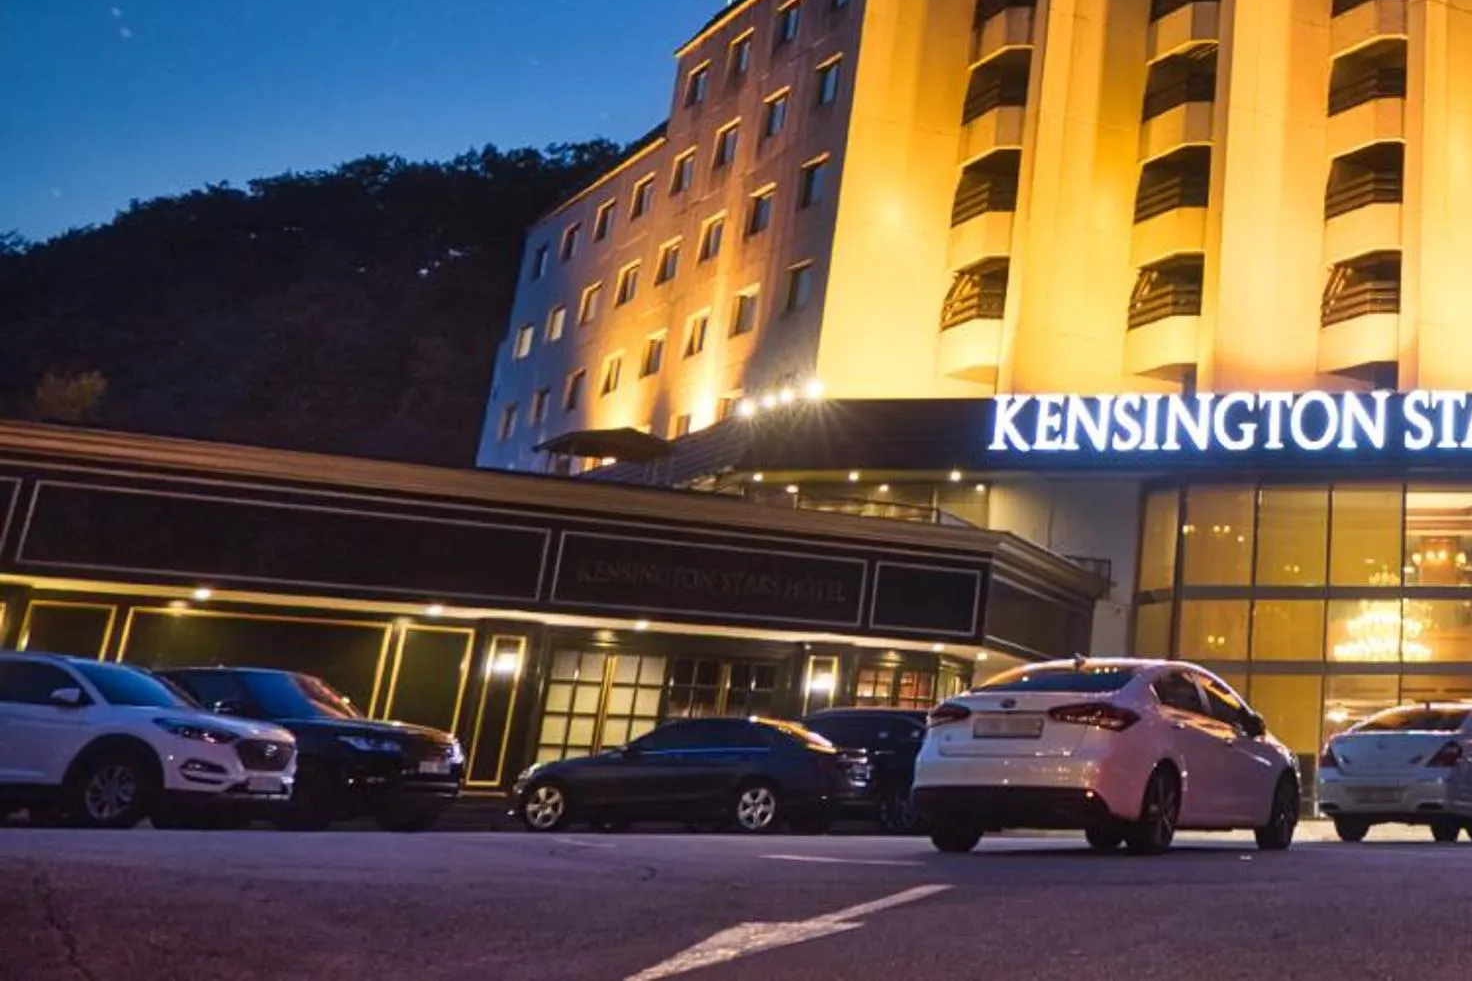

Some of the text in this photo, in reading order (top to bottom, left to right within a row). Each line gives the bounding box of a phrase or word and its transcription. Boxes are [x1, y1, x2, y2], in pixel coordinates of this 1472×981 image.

[988, 390, 1391, 451] KENSINGTON
[577, 559, 847, 603] KENSINGTON STARS HOTEL
